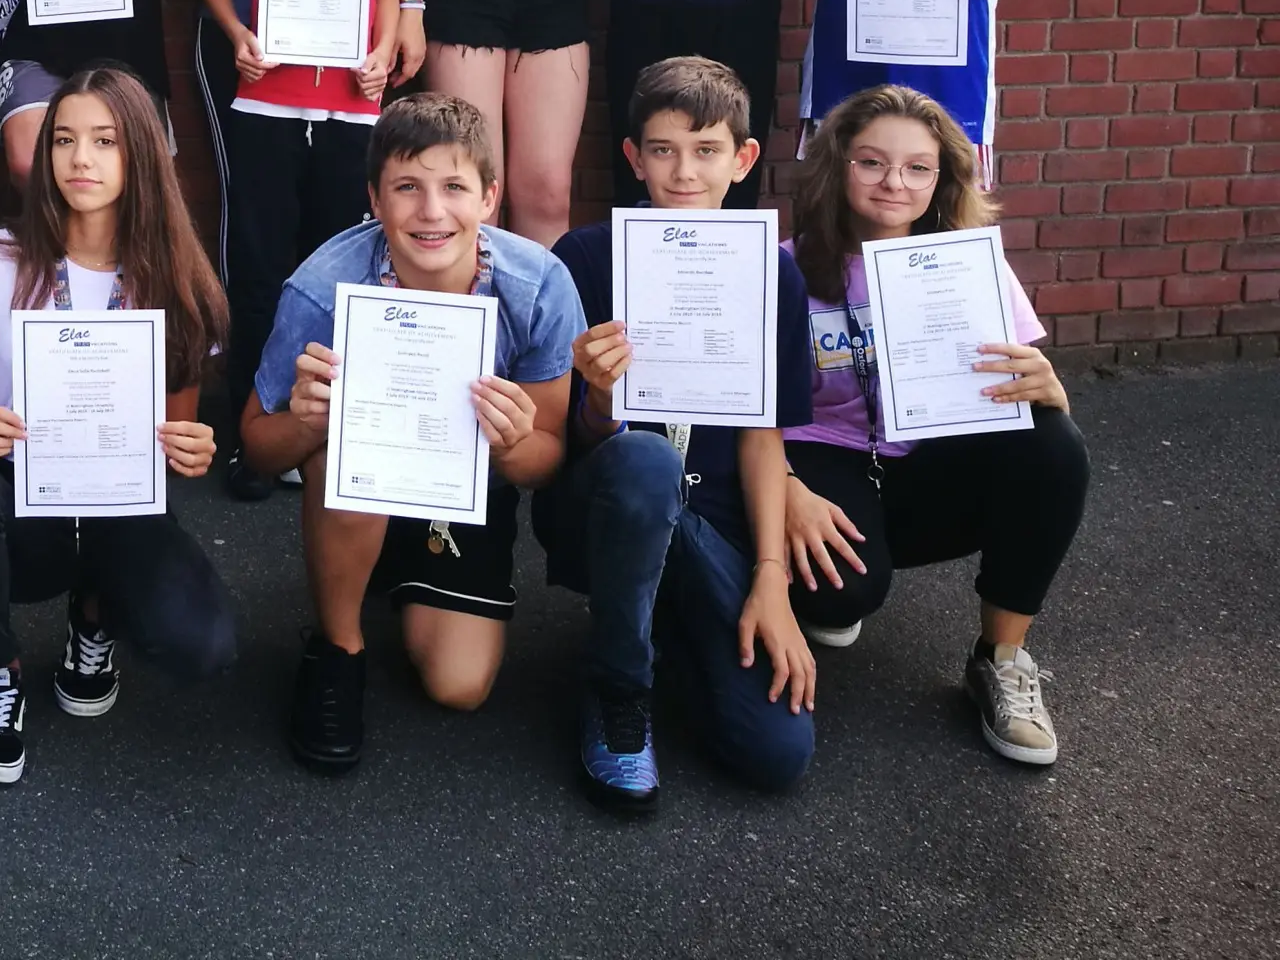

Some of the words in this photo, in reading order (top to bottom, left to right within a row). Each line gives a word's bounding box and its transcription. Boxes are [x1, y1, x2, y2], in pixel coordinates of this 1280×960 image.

[663, 227, 697, 242] Elac
[909, 252, 937, 268] Elac
[384, 306, 418, 321] Elac
[58, 328, 90, 342] Elac
